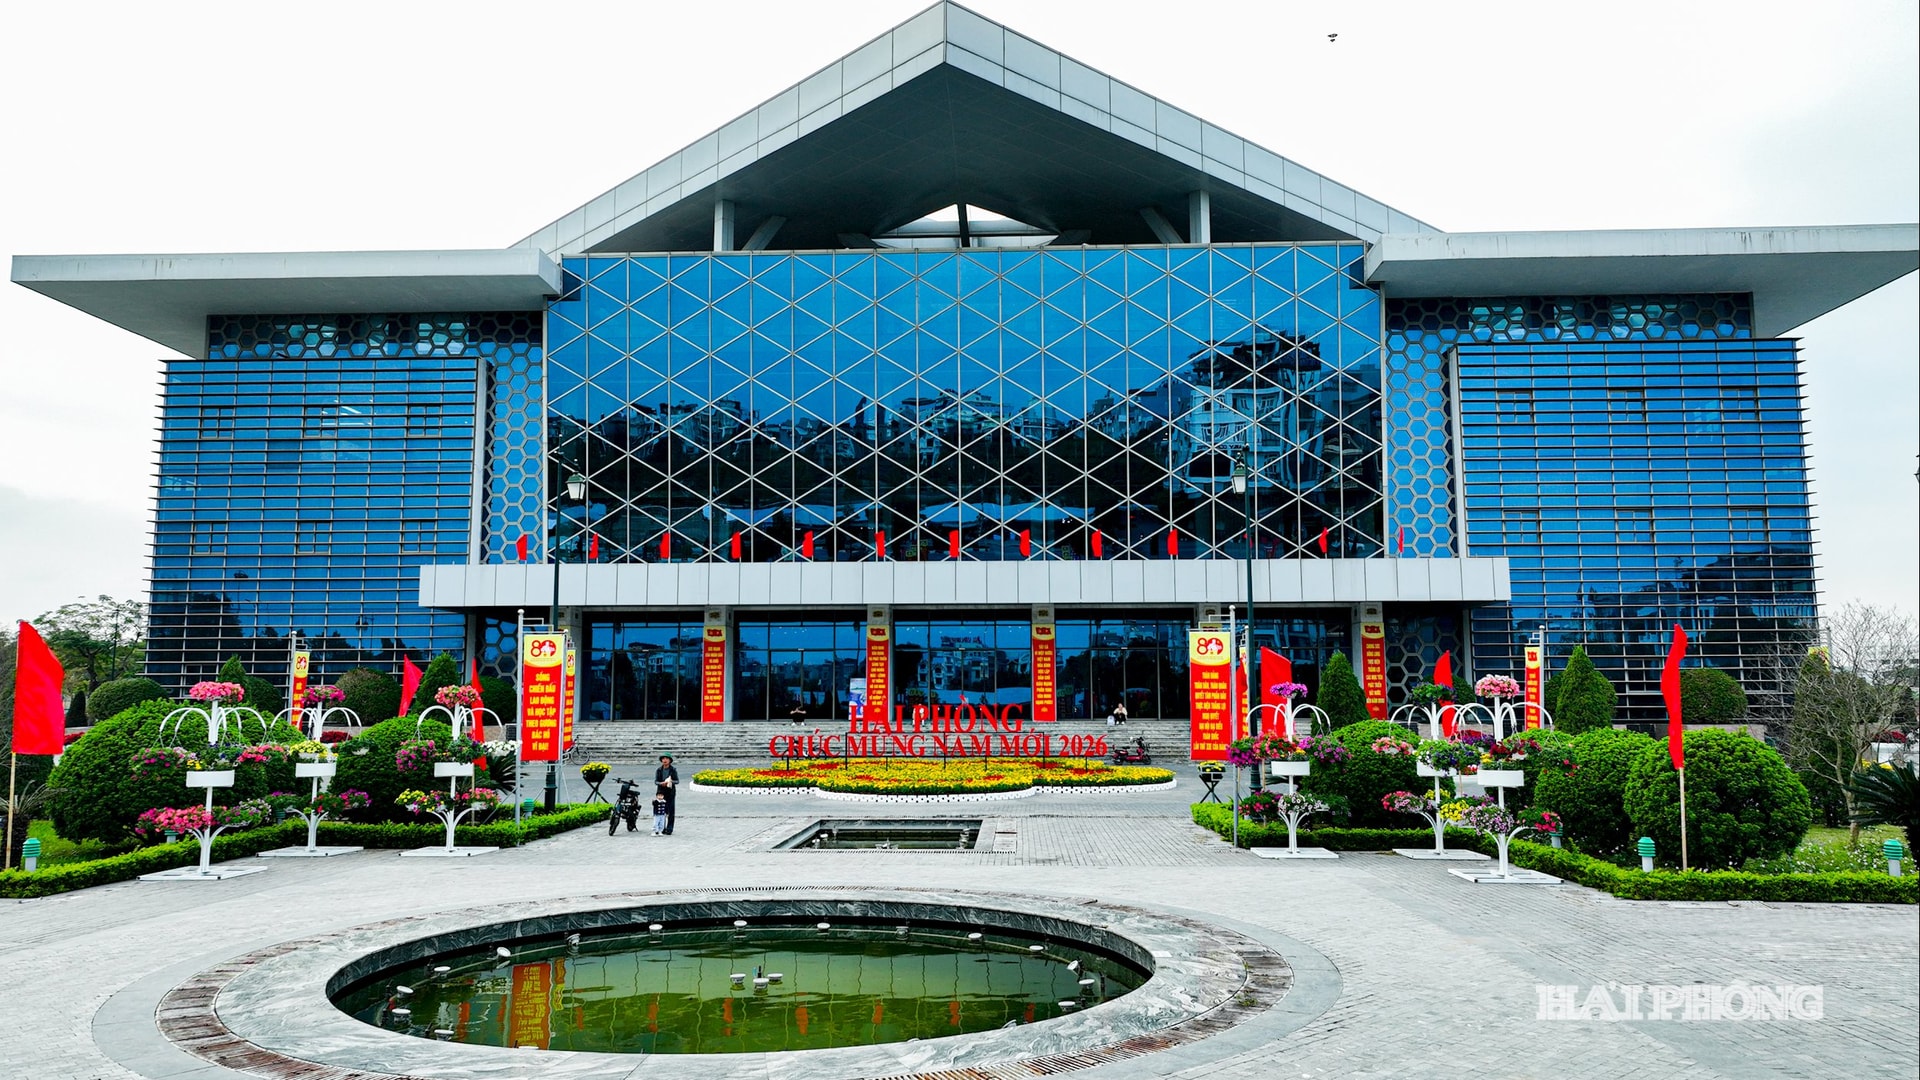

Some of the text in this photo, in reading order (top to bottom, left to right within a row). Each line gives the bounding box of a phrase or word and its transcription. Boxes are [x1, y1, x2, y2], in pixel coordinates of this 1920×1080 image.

[911, 694, 1025, 733] PHÒNG
[769, 728, 841, 758] CHÚC
[999, 728, 1052, 758] MỚI
[1059, 734, 1109, 757] 2026
